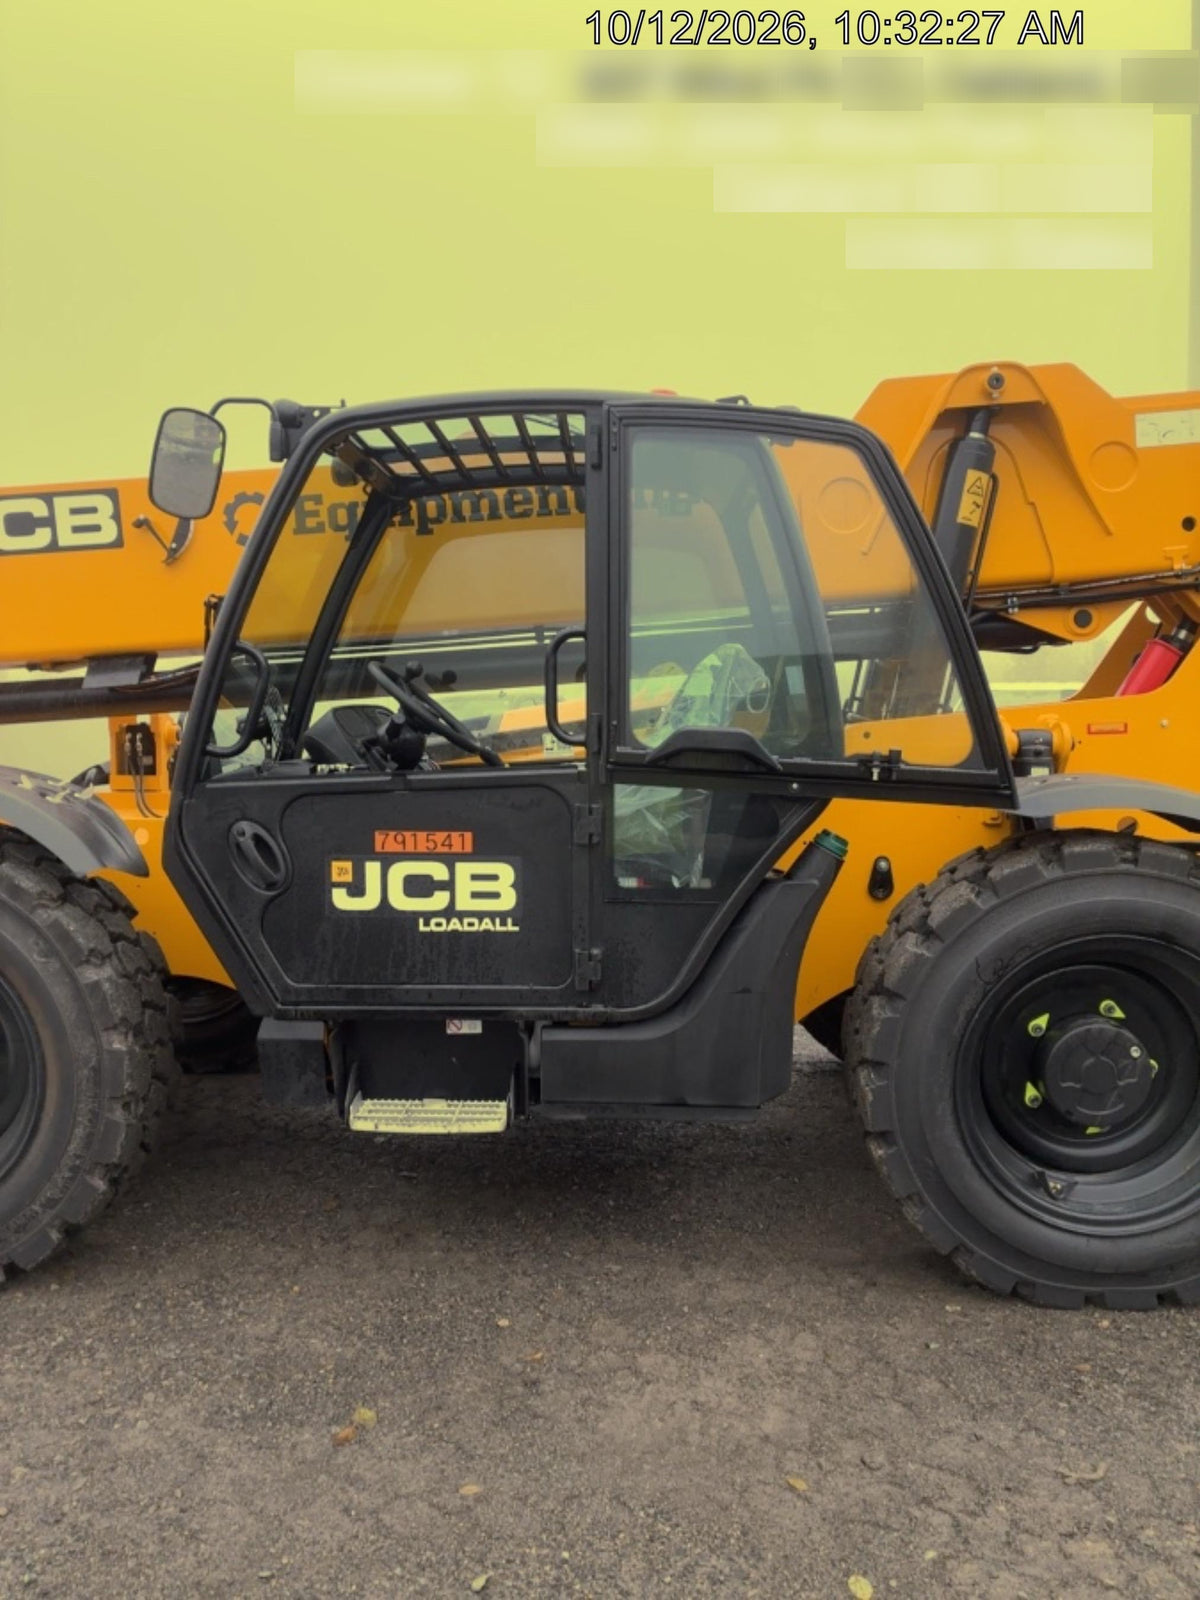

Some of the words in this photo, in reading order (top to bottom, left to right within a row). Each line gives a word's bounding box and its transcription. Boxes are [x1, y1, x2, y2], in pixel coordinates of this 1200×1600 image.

[378, 833, 467, 851] 791541
[331, 860, 517, 912] JCB
[418, 917, 520, 932] LOADALL
